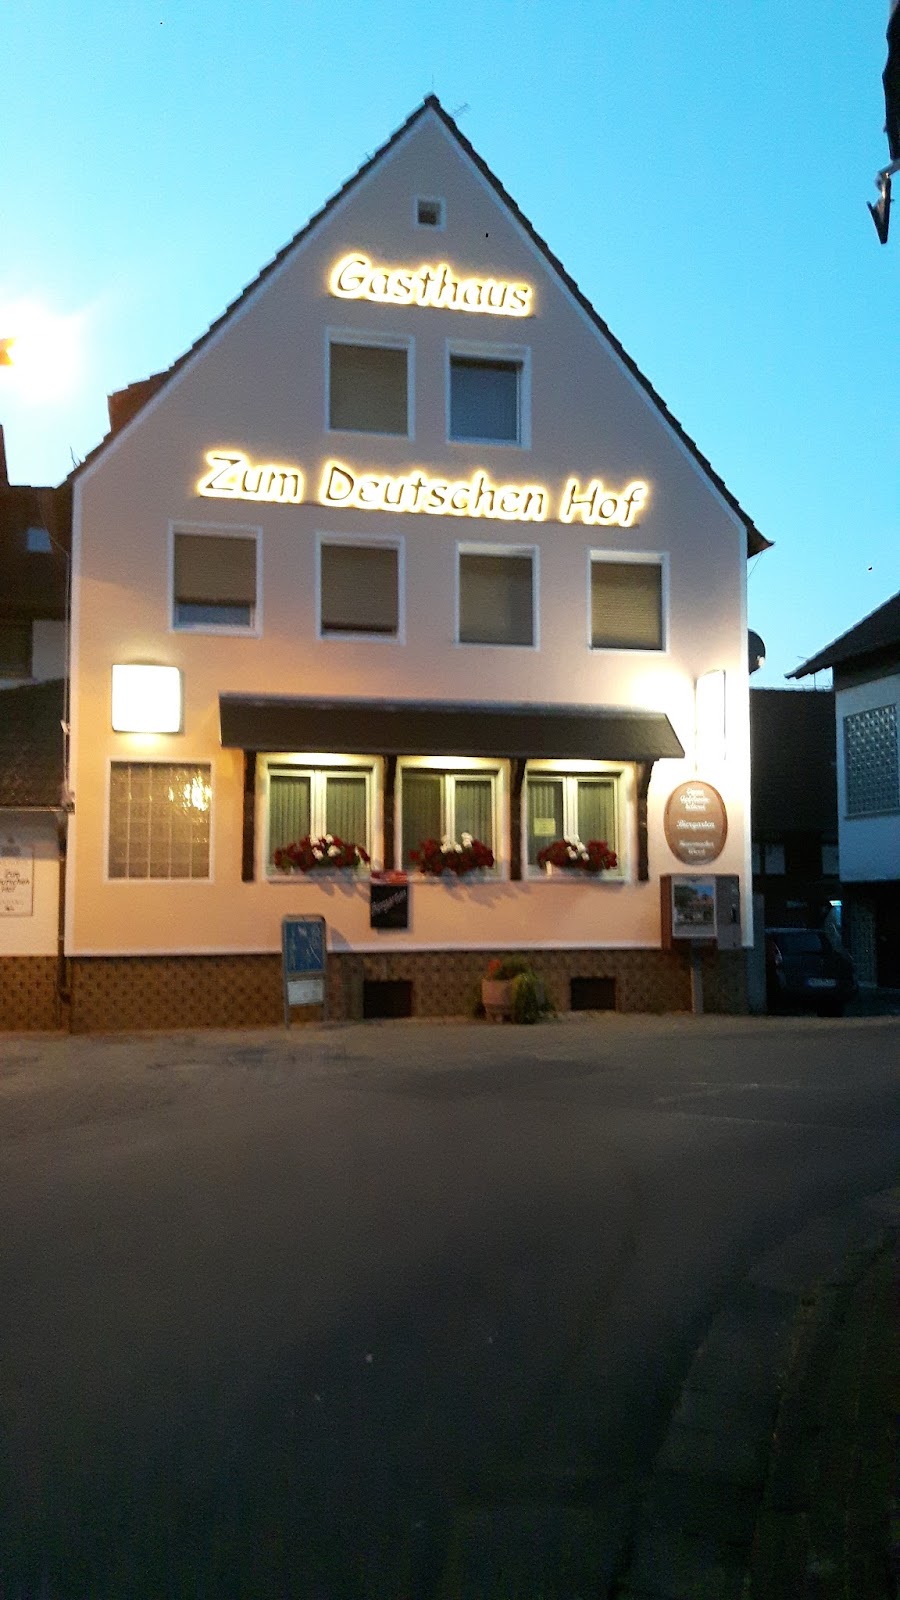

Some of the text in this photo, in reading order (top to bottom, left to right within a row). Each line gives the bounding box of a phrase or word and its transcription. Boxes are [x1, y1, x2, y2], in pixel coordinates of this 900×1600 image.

[333, 254, 532, 314] Gasthaus
[200, 453, 648, 526] Zum Deutschen Hof
